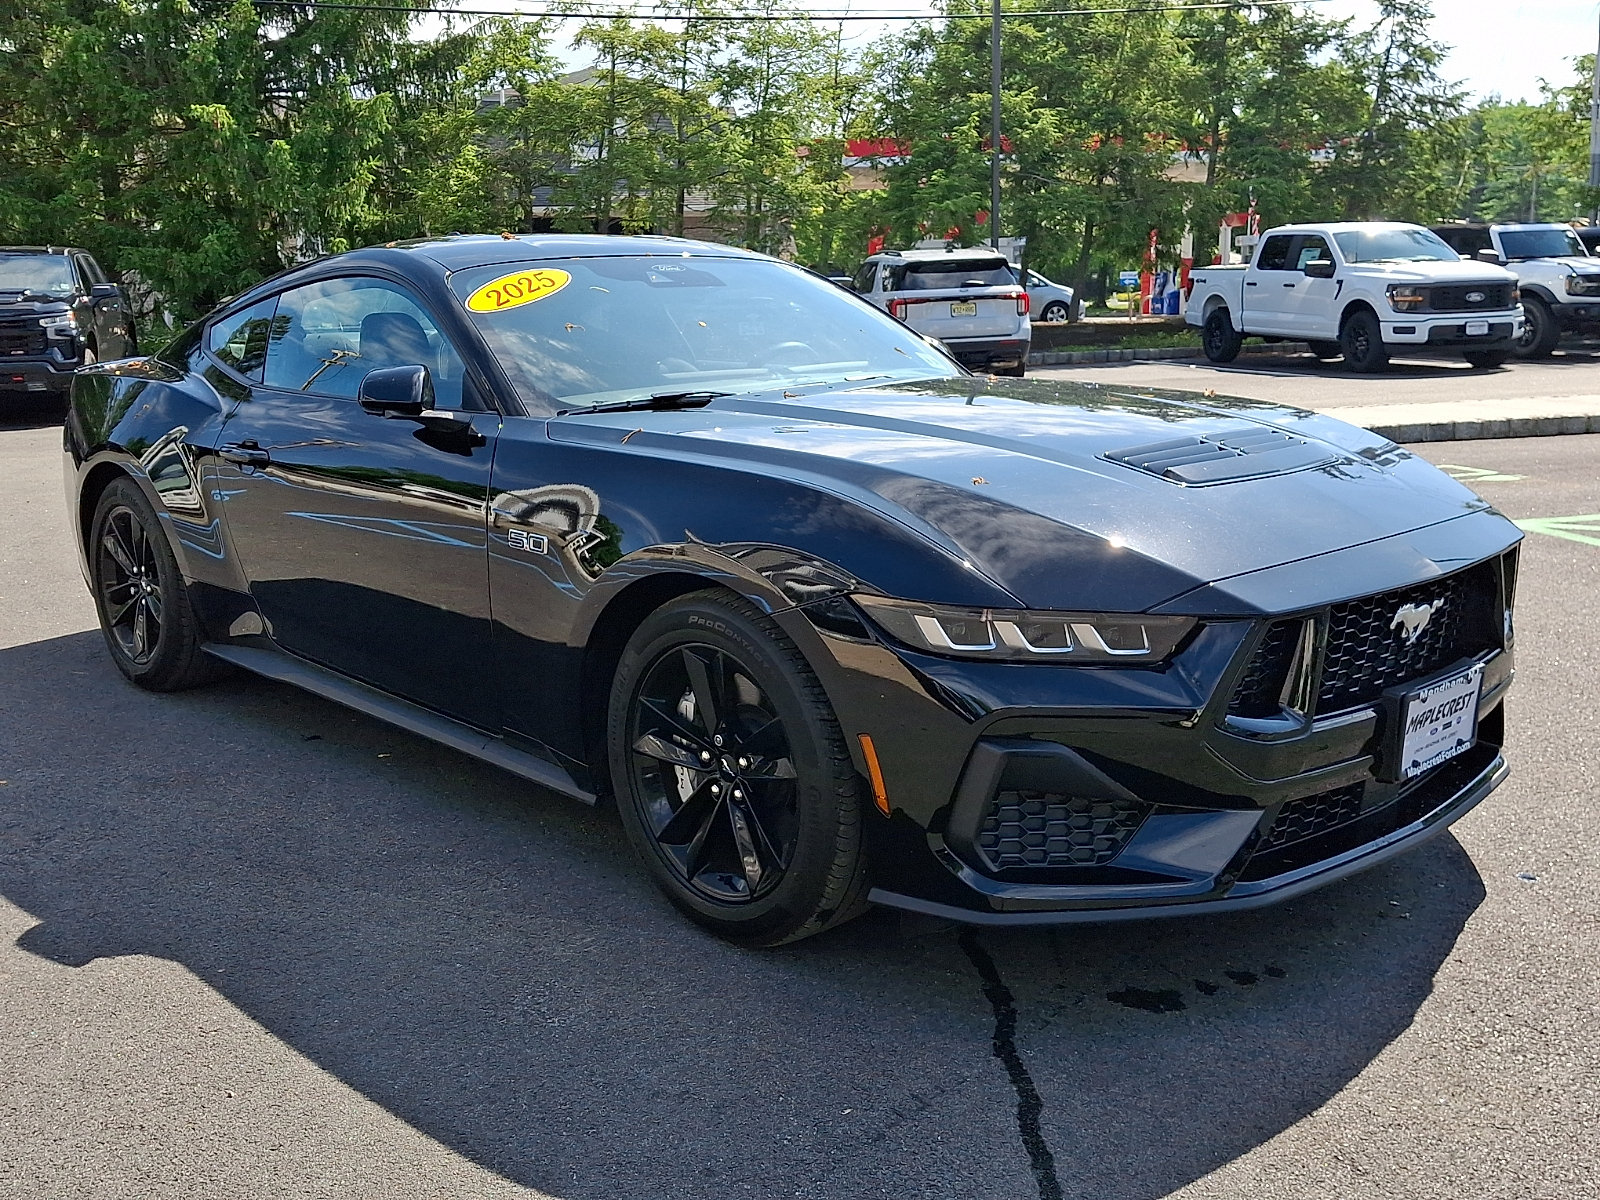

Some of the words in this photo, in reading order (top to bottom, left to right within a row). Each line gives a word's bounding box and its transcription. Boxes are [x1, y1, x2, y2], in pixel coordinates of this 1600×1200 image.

[486, 272, 556, 307] 2025
[508, 529, 549, 555] 5.0
[1405, 690, 1475, 735] MAPLECREST
[1407, 741, 1471, 778] MaplecrestFord.com
